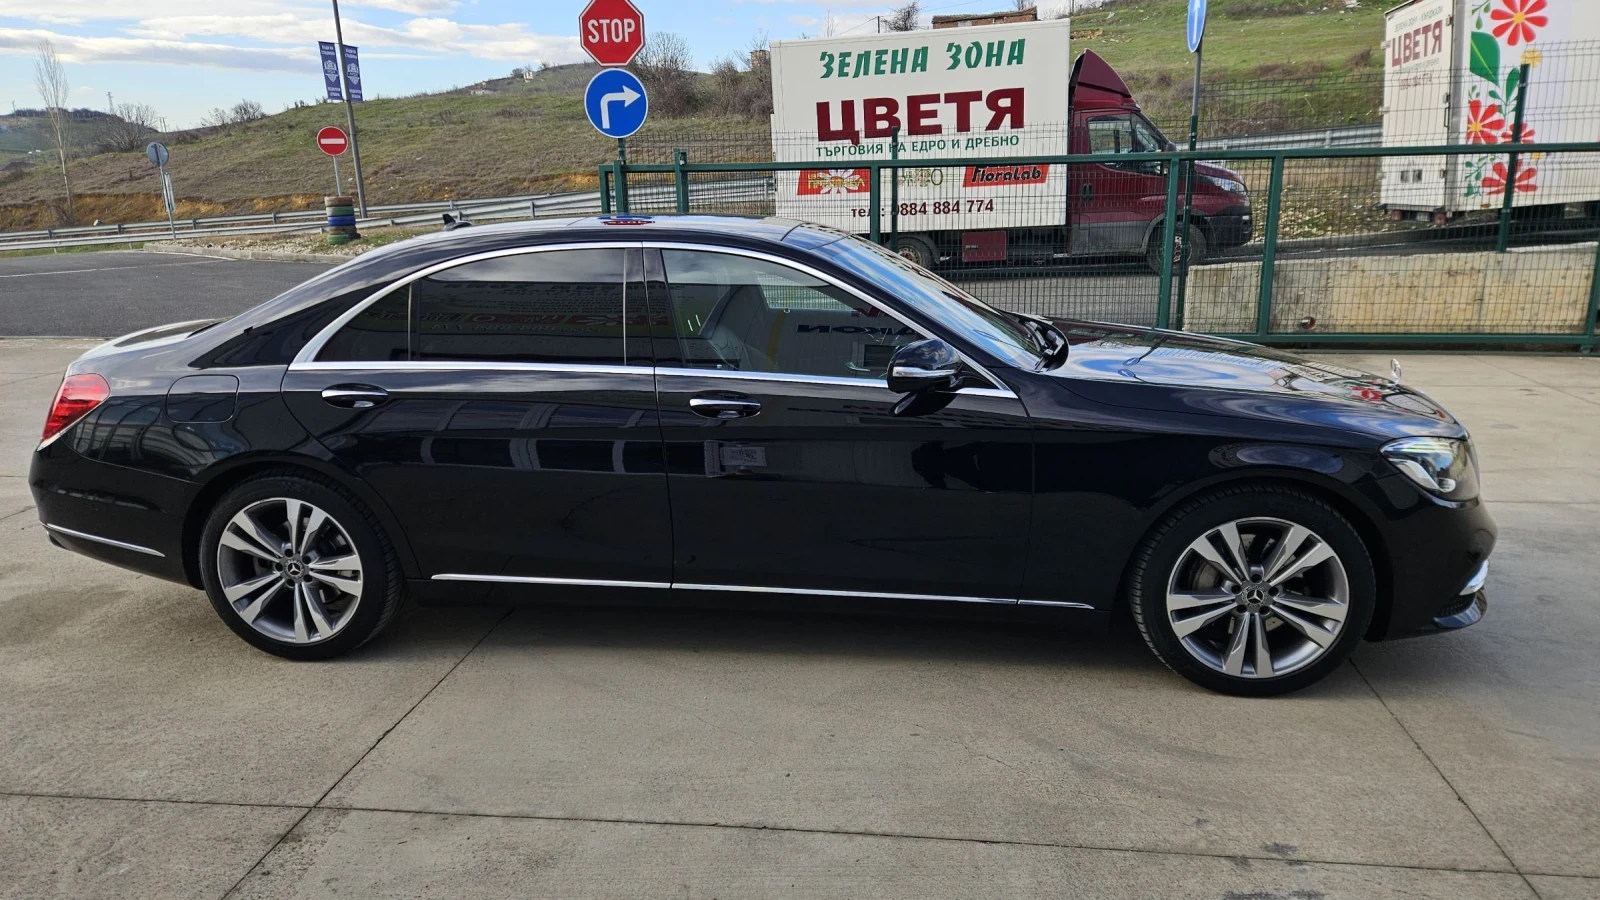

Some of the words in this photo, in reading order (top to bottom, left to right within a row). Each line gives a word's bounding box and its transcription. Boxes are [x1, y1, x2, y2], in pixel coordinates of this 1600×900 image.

[588, 18, 635, 44] STOP
[1391, 20, 1443, 68] ЦВЕТЯ
[820, 46, 929, 78] ЗЕЛЕНА
[946, 39, 1026, 70] ЗОНА
[816, 87, 1025, 146] ЦВЕТЯ
[816, 143, 884, 157] ТЪРГОВИЯ
[911, 139, 946, 154] ЕДРО
[952, 139, 960, 148] И
[965, 134, 1020, 152] ДРЕБНО
[971, 166, 1043, 184] FloraLab
[932, 199, 961, 216] 884
[966, 198, 995, 214] 774
